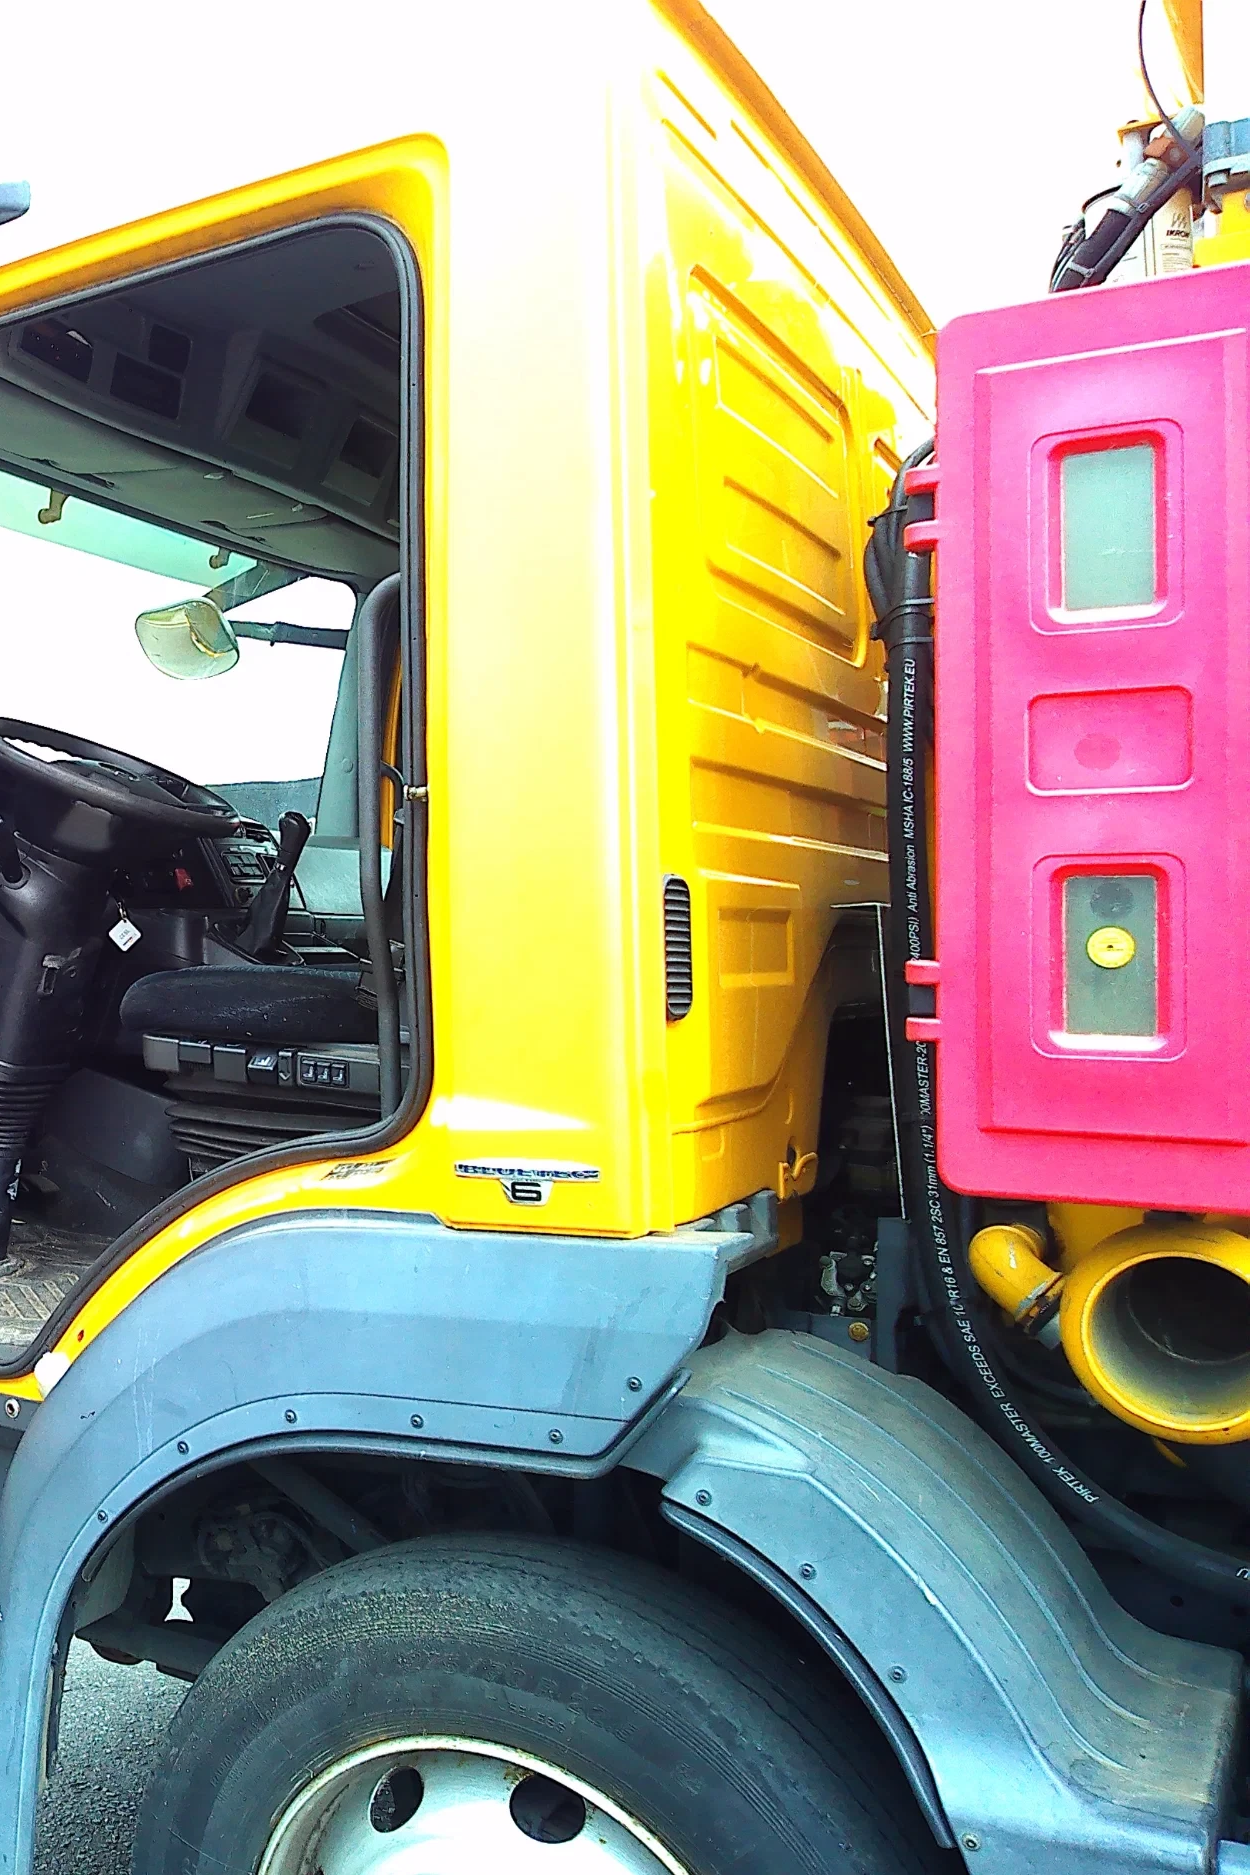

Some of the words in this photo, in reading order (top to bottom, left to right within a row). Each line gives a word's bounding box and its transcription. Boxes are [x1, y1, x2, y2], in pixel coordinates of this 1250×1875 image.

[902, 657, 917, 753] WWW.PIRTEK.EU
[902, 757, 915, 804] IC-188/5
[903, 806, 916, 839] MSHA
[904, 844, 917, 892] Abrasion
[906, 891, 918, 913] Anti
[510, 1181, 542, 1202] 6
[926, 1165, 940, 1198] 31mm
[928, 1199, 945, 1223] 2SC
[931, 1224, 948, 1246] 857
[937, 1247, 952, 1264] EN
[941, 1265, 954, 1277] &
[957, 1319, 977, 1343] SAE
[968, 1344, 1006, 1399] EXCEEDS
[1000, 1402, 1056, 1464] 100MASTER
[1051, 1465, 1100, 1504] PIRTEK
